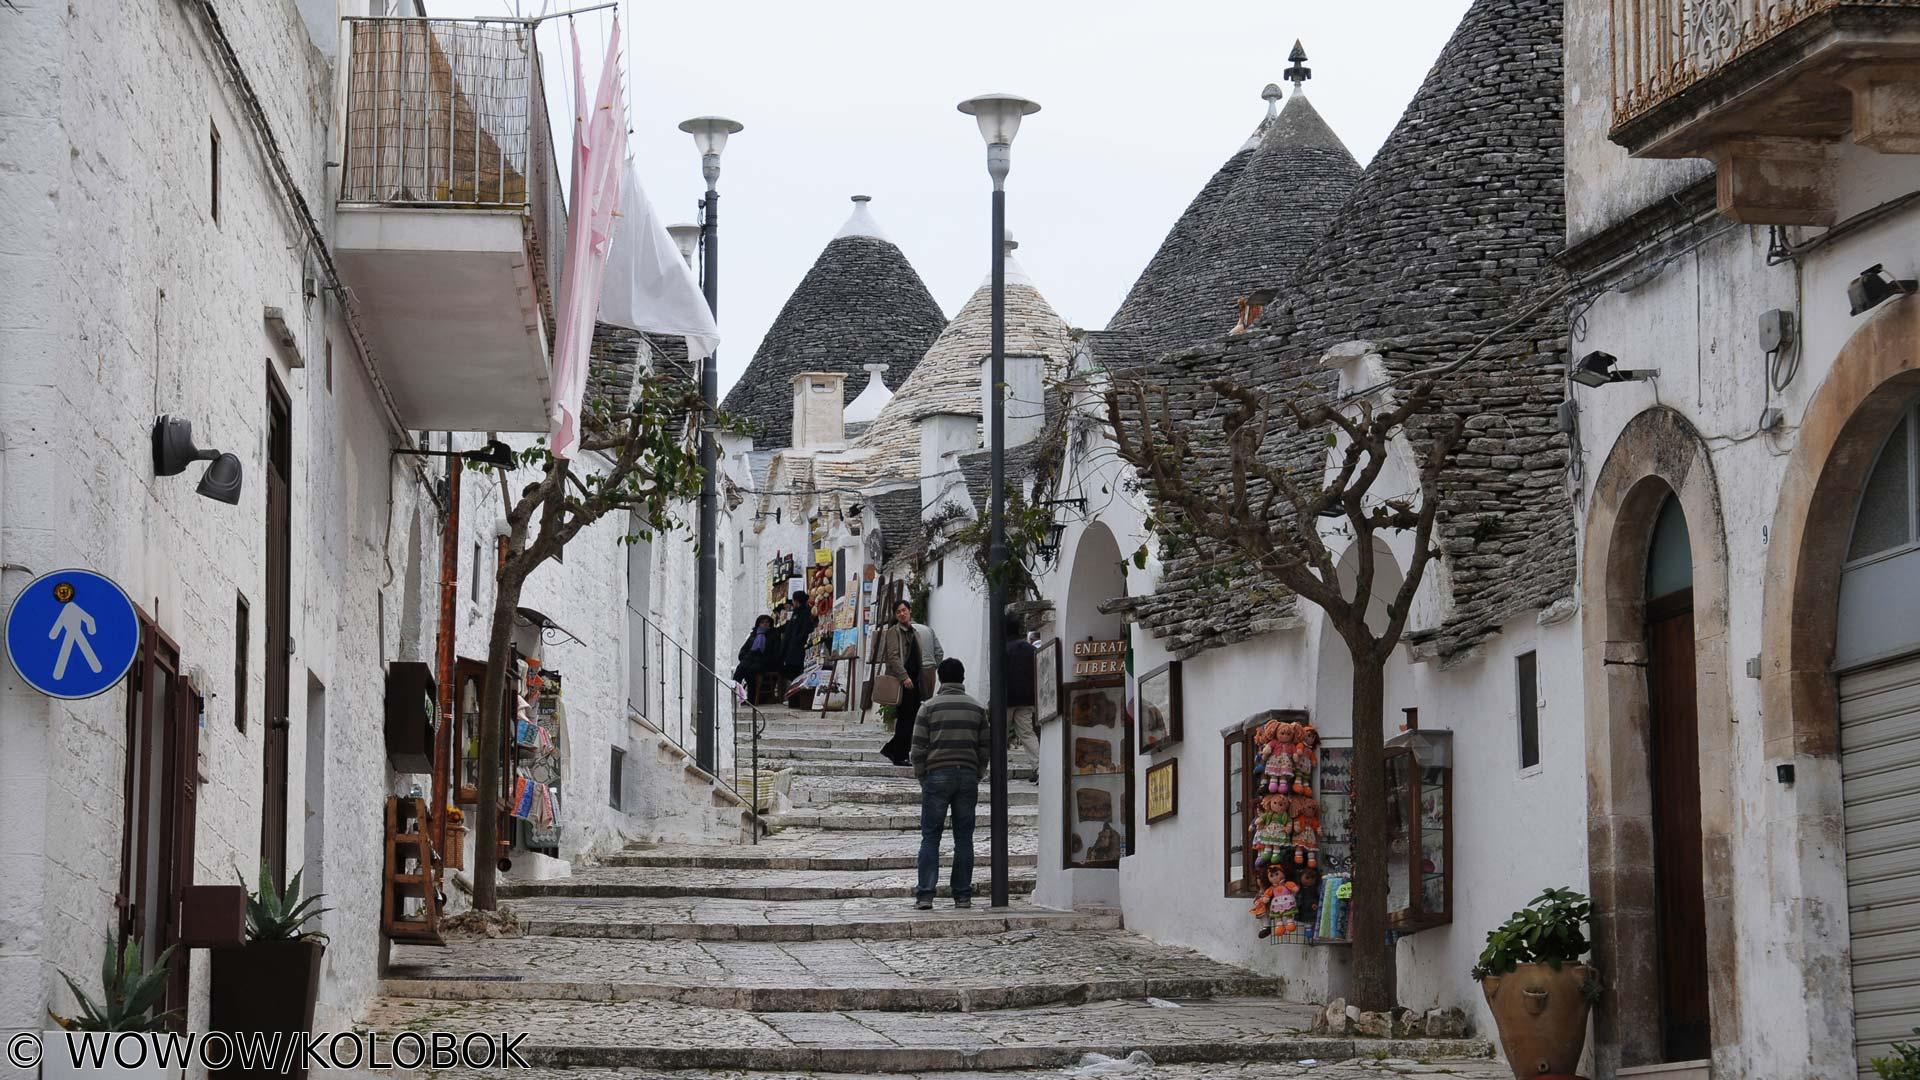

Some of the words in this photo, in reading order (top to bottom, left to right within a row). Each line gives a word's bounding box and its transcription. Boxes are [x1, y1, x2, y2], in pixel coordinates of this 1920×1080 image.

[1762, 525, 1768, 545] 9
[1075, 641, 1128, 654] ENTRAT
[1076, 661, 1126, 674] LIBERA
